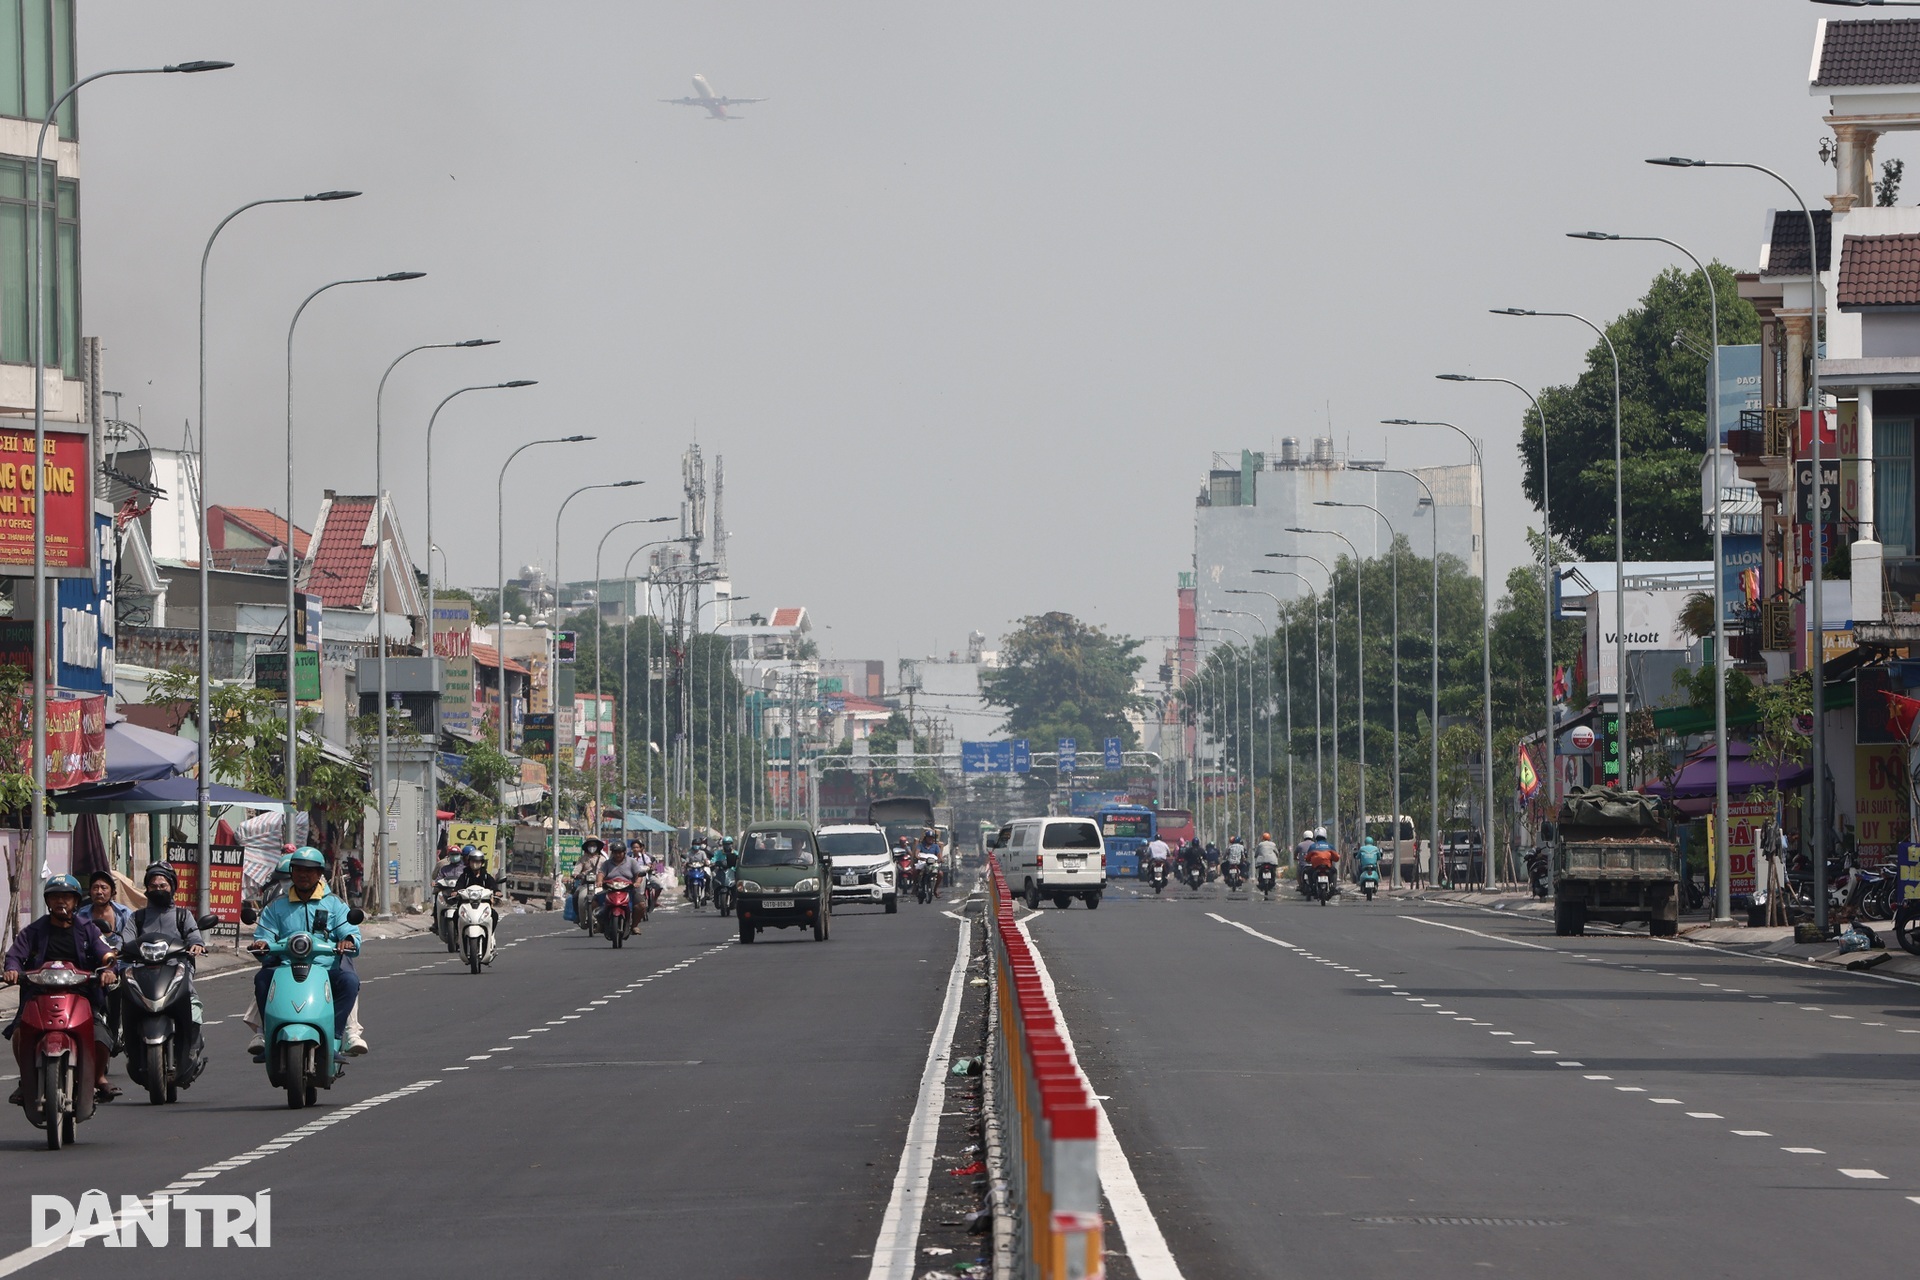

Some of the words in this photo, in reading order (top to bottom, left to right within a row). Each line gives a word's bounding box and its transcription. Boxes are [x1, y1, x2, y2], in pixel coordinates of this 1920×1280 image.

[22, 437, 56, 454] MNH
[8, 519, 33, 530] OFFICE
[1725, 551, 1762, 566] LUÔN
[1605, 632, 1659, 643] Vetlott
[456, 826, 489, 841] CẮT
[169, 845, 186, 862] SỬA
[212, 850, 222, 864] XE
[223, 848, 242, 865] MÁY
[211, 870, 218, 878] XE
[179, 880, 188, 889] XE
